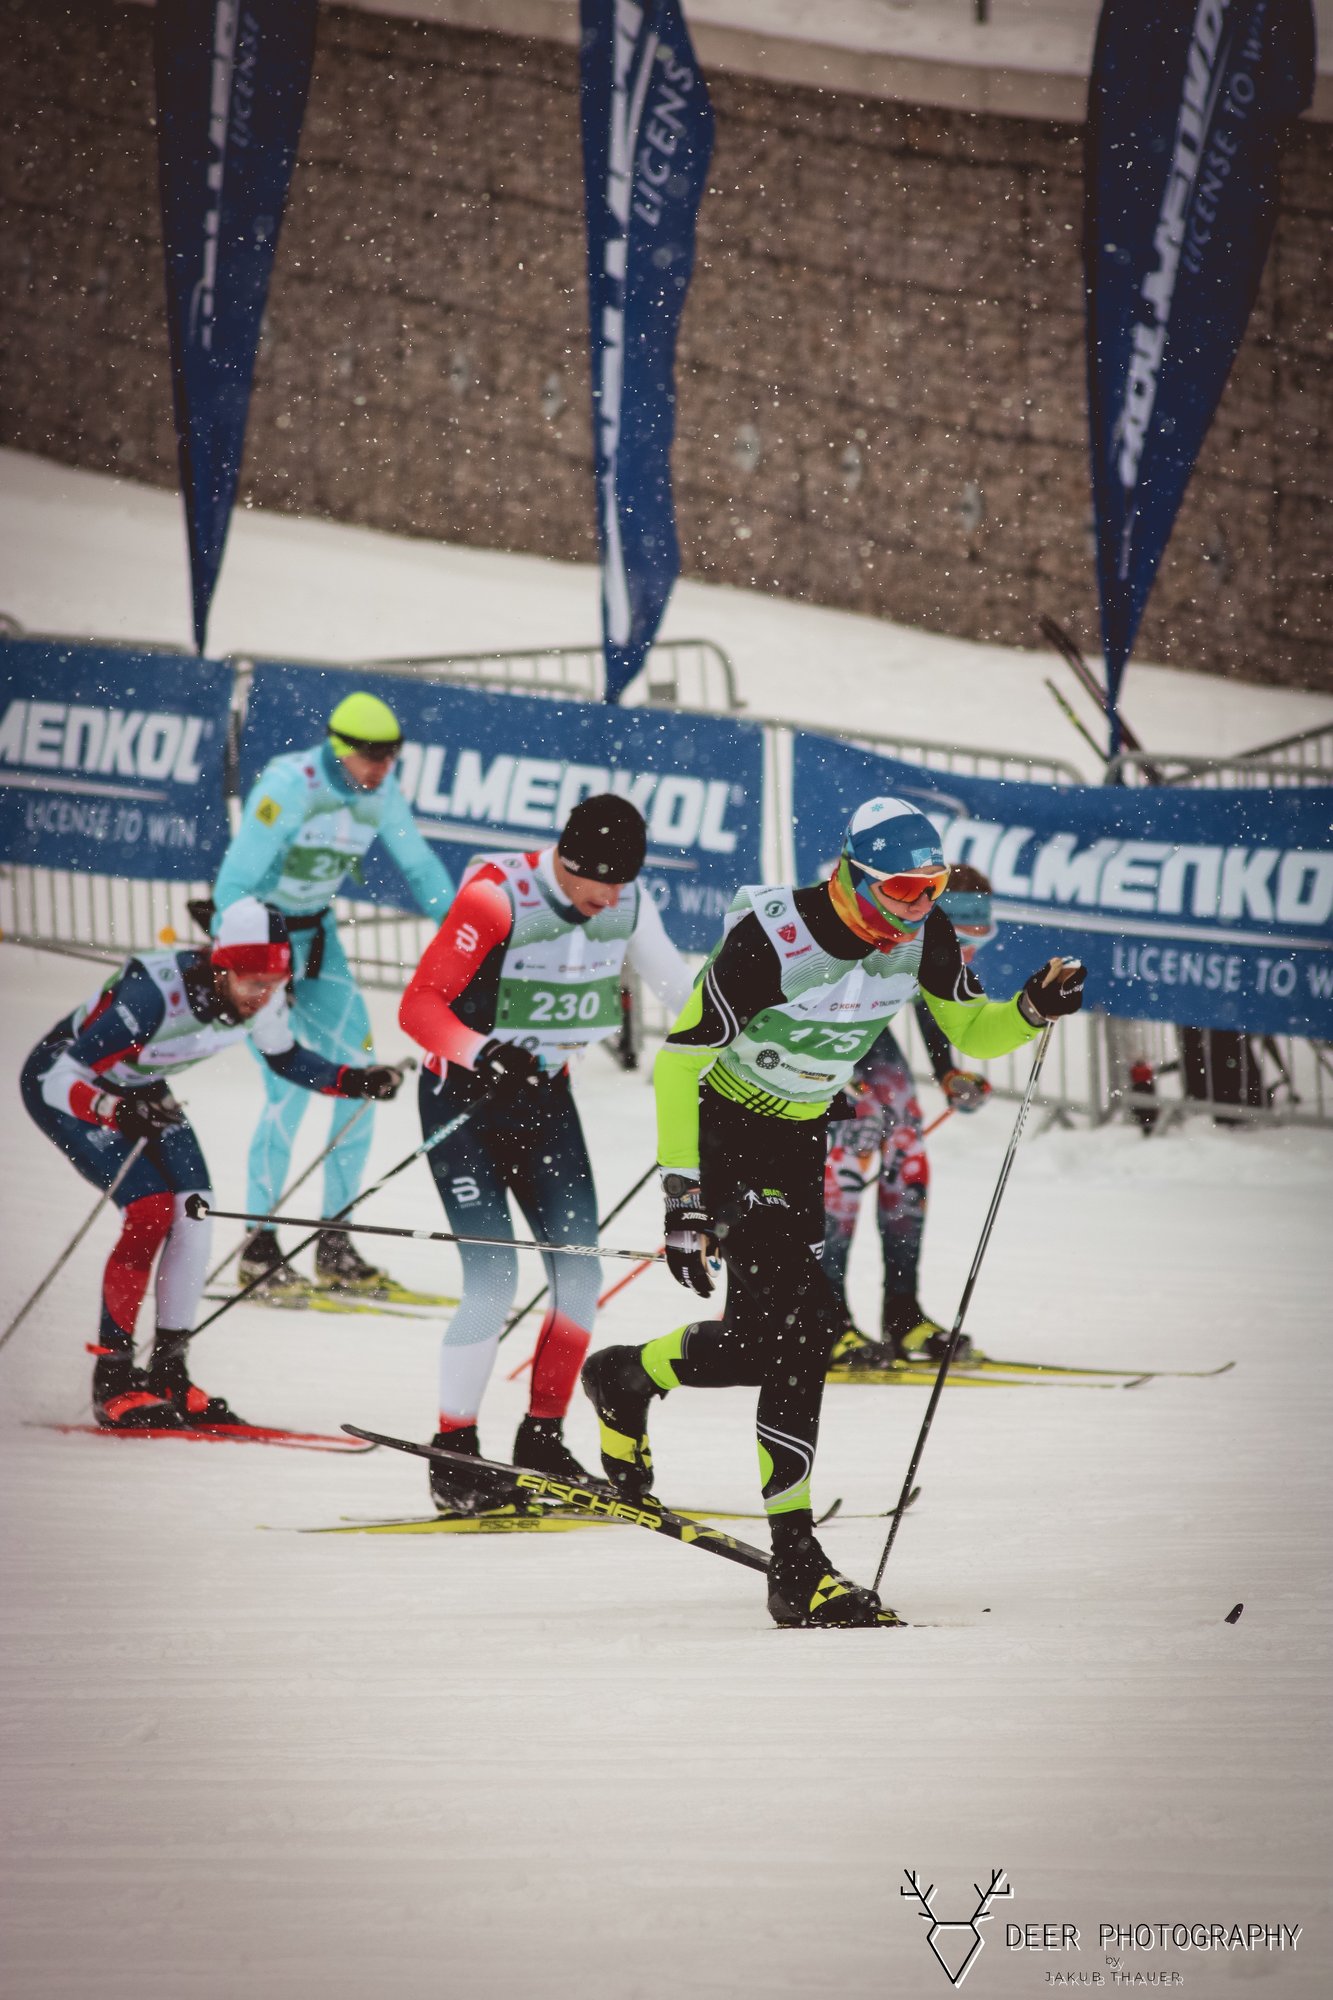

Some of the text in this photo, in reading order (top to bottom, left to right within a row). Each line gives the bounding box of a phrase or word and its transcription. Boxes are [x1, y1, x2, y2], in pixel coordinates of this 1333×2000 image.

[25, 799, 198, 848] LICENSE TO WIN
[1112, 944, 1243, 993] LICENSE
[1256, 957, 1298, 997] TO
[529, 991, 600, 1021] 230
[789, 1027, 869, 1054] 175
[516, 1474, 663, 1532] FISCHER
[479, 1519, 540, 1530] FISCHER
